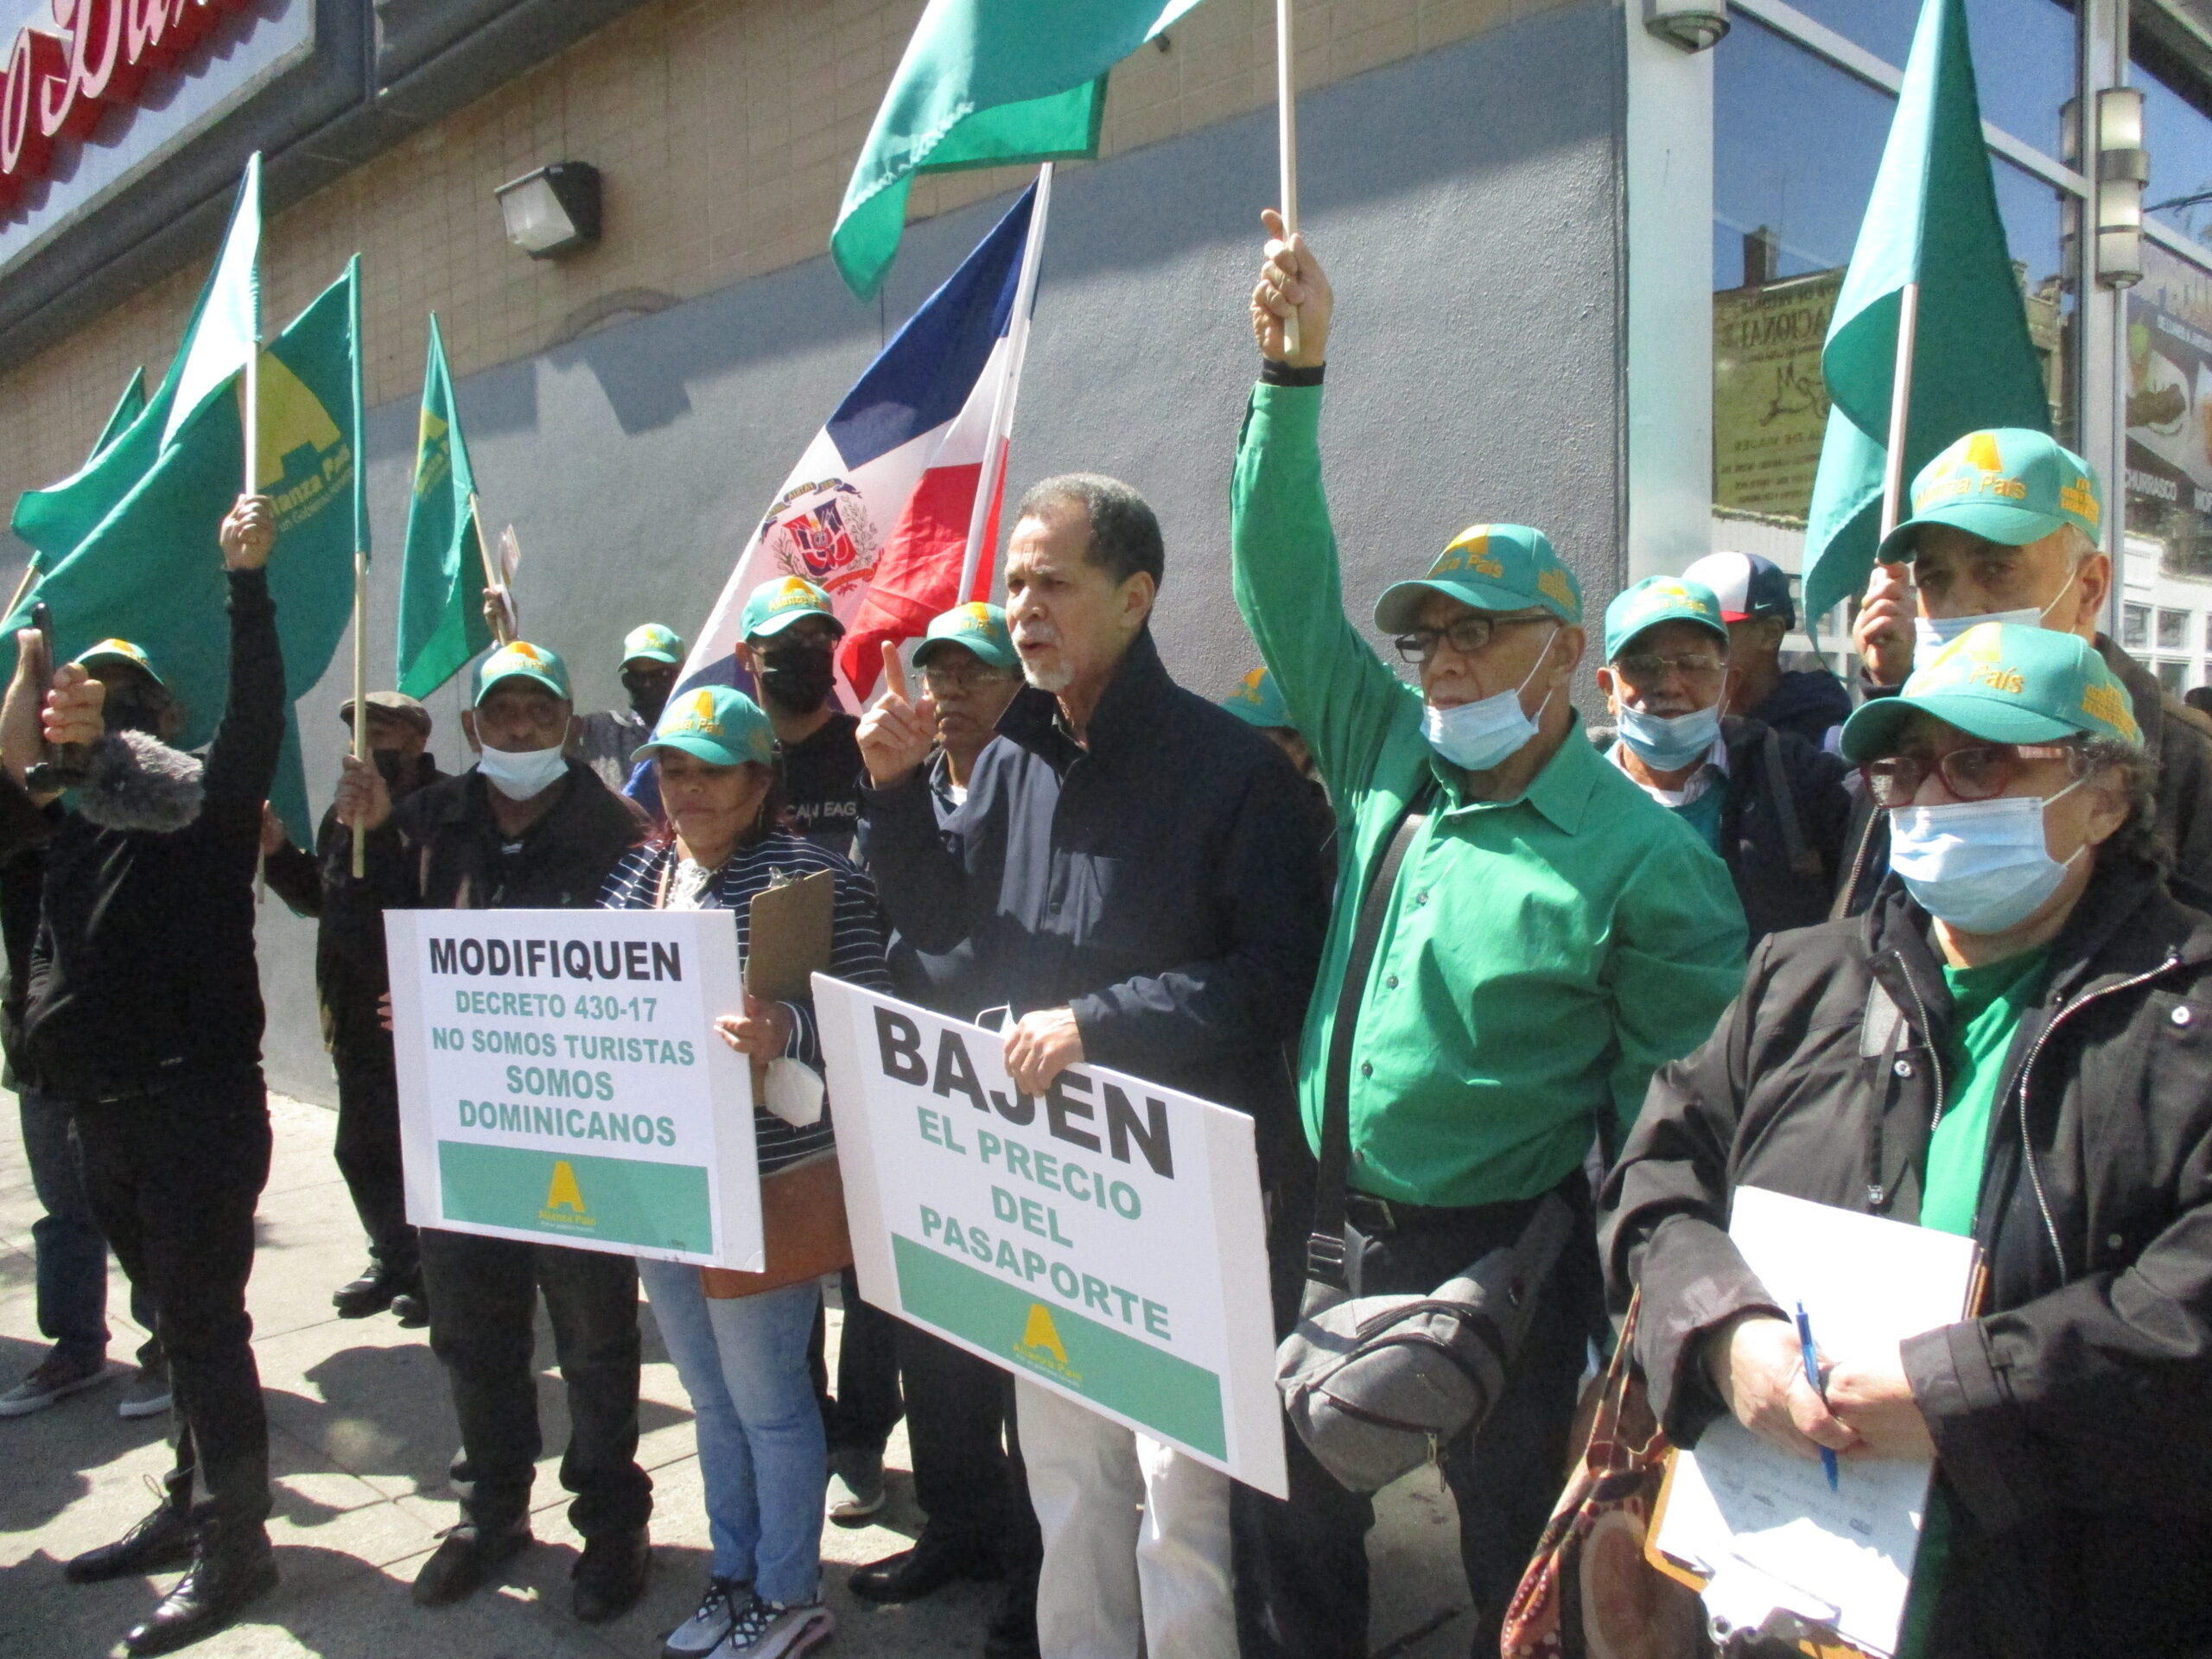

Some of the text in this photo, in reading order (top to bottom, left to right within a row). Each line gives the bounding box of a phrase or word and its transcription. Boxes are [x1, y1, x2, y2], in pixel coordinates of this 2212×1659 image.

[429, 938, 683, 982] MODIFIQUEN
[455, 990, 658, 1023] DECRETO 430-17
[432, 1027, 696, 1067] NO SOMOS TURISTAS
[505, 1065, 614, 1102] SOMOS
[873, 1005, 1175, 1181] BAJEN
[458, 1099, 677, 1147] DOMINICANOS
[917, 1106, 1142, 1221] EL PRECIO
[990, 1185, 1074, 1249] DEL
[919, 1205, 1173, 1342] PASAPORTE
